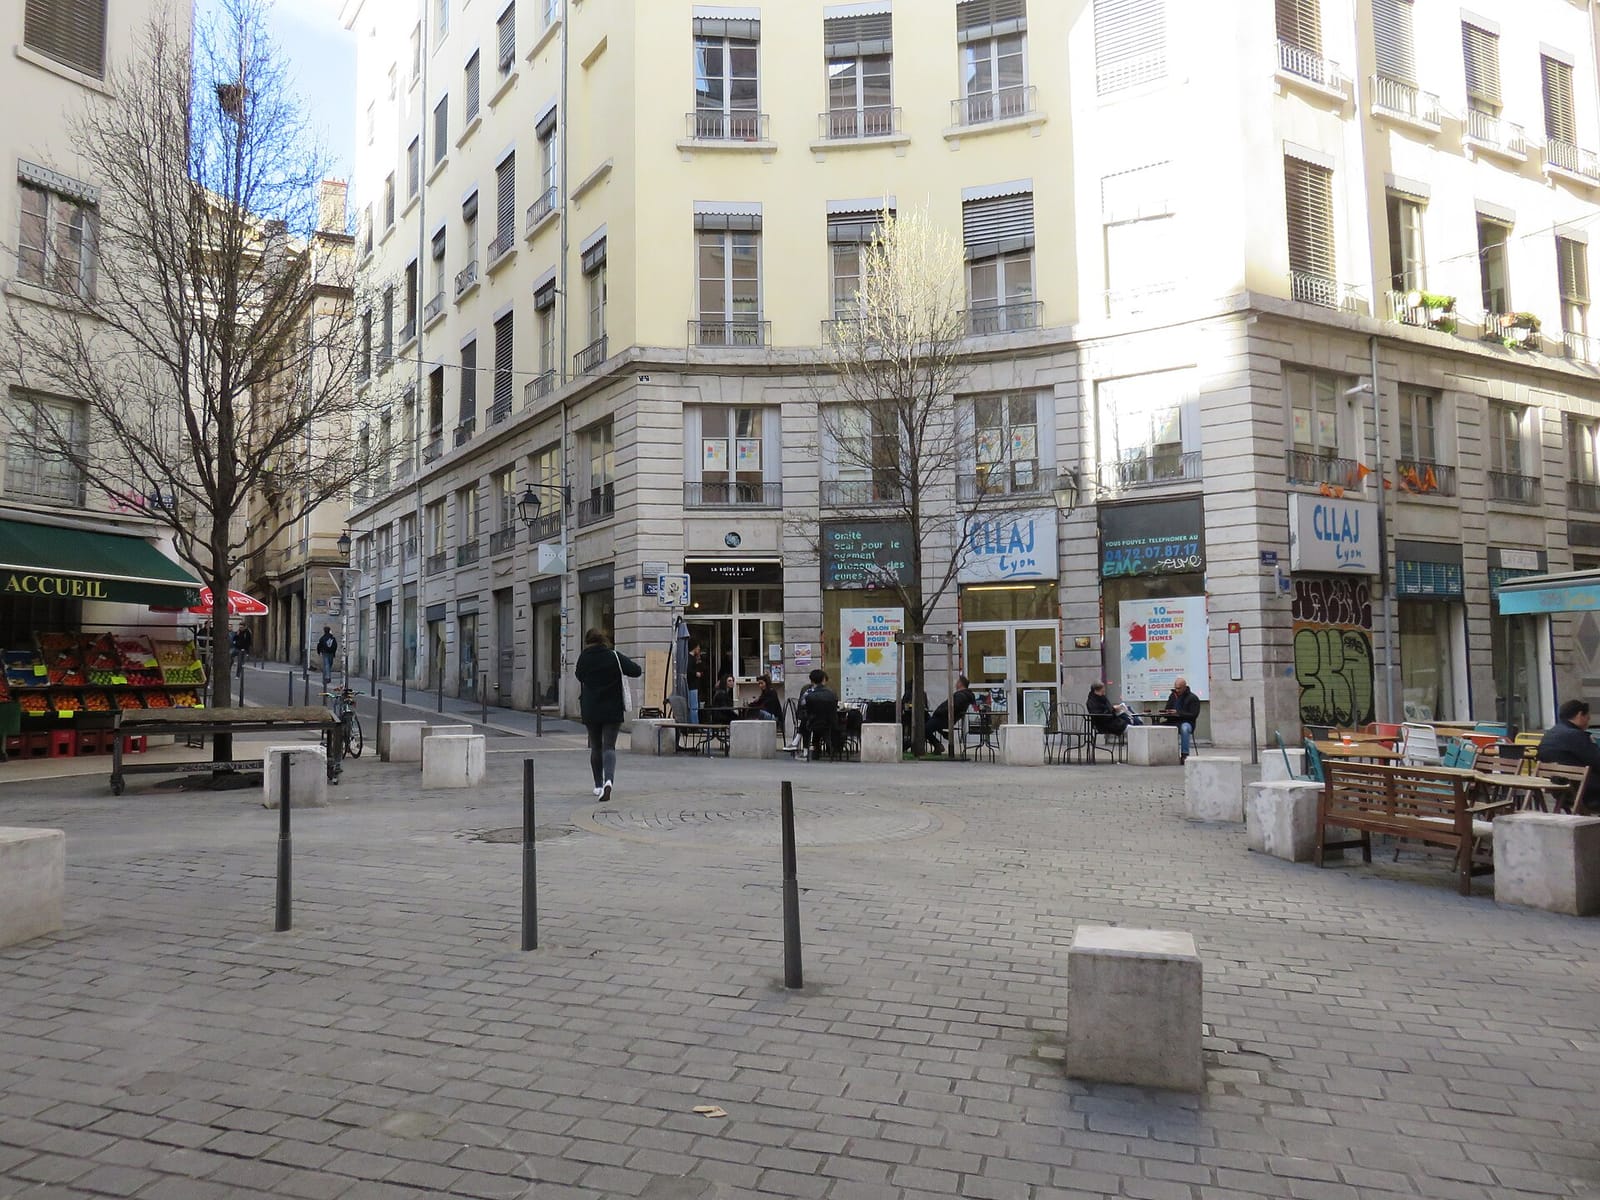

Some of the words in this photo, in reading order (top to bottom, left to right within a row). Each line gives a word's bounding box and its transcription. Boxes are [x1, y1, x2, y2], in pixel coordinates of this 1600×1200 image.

[1313, 504, 1359, 543] CLLAJ
[970, 520, 1035, 554] CLLAJ
[861, 542, 884, 551] pour
[1336, 543, 1362, 562] Lyon
[830, 561, 878, 570] Autonom
[1000, 555, 1035, 572] Lyon
[4, 574, 108, 599] ACCUEIL
[872, 615, 884, 623] 10
[1153, 606, 1166, 615] 10
